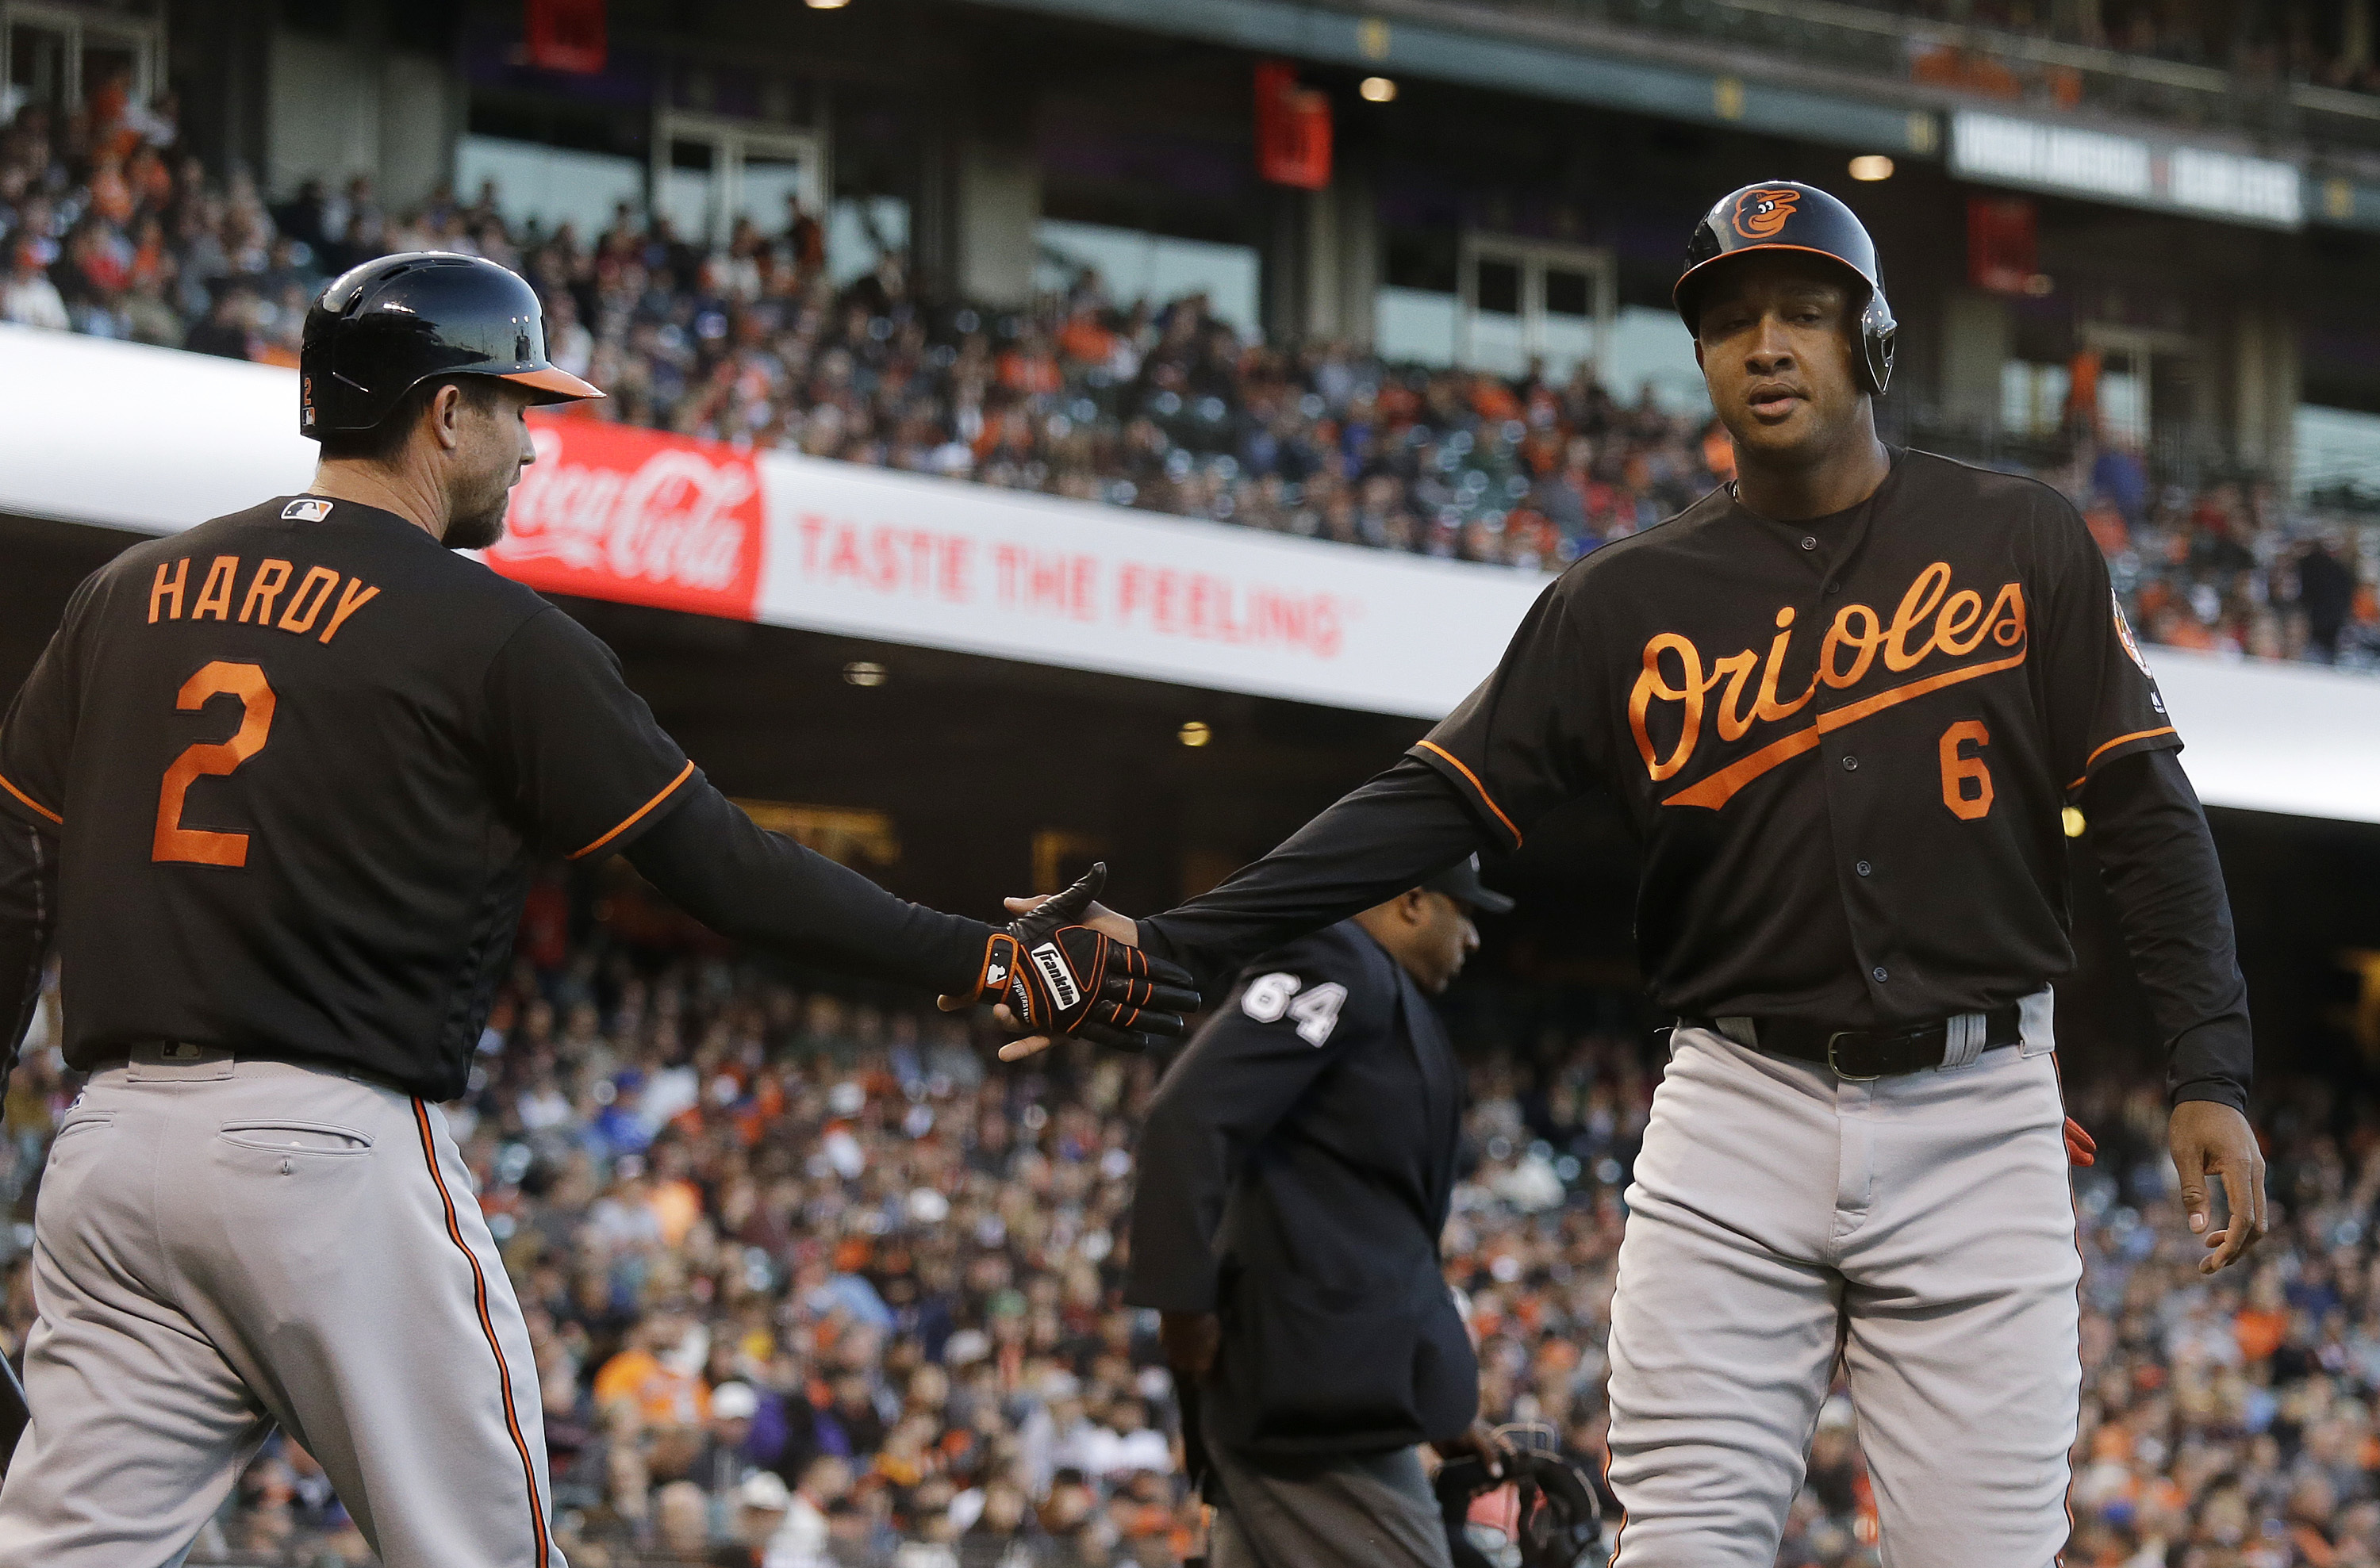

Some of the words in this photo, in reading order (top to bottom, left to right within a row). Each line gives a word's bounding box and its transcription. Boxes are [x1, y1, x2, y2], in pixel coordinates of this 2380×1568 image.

[304, 378, 312, 405] 2
[148, 555, 381, 644] HARDY
[797, 512, 973, 603] TASTE
[995, 542, 1098, 620] THE
[1115, 559, 1345, 658] FEELING
[1628, 562, 2028, 782] Orioles
[152, 661, 277, 867] 2
[1939, 720, 1994, 820] 6
[1032, 949, 1074, 1006] Franklin
[1241, 972, 1348, 1048] 64
